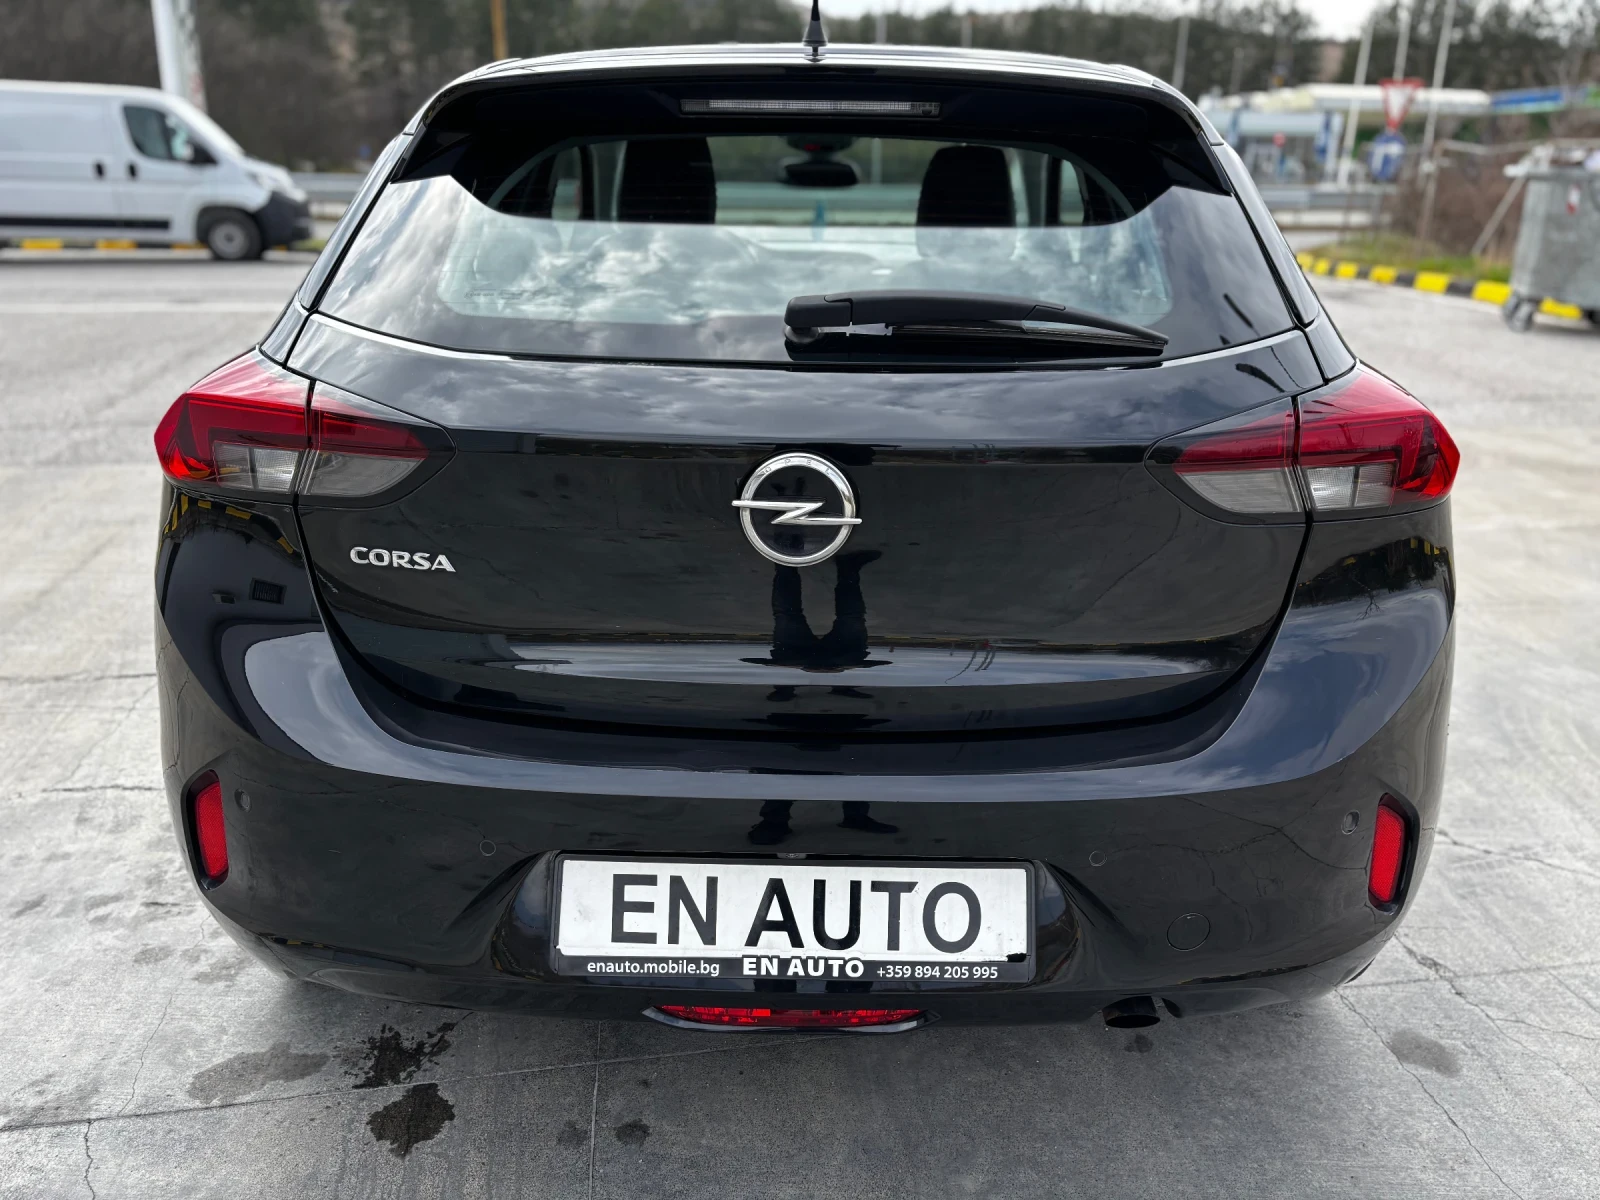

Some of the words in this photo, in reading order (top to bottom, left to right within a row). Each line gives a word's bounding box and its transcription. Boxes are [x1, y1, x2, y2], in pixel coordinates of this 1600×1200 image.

[350, 546, 457, 573] CORSA
[611, 873, 719, 946] EN
[744, 877, 982, 954] AUTO
[587, 960, 720, 977] enauto.mobile.bg
[742, 957, 779, 976] EN
[786, 958, 865, 978] AUTO
[876, 965, 912, 978] +359
[914, 965, 941, 979] 894
[943, 966, 969, 979] 205
[972, 966, 999, 979] 995
